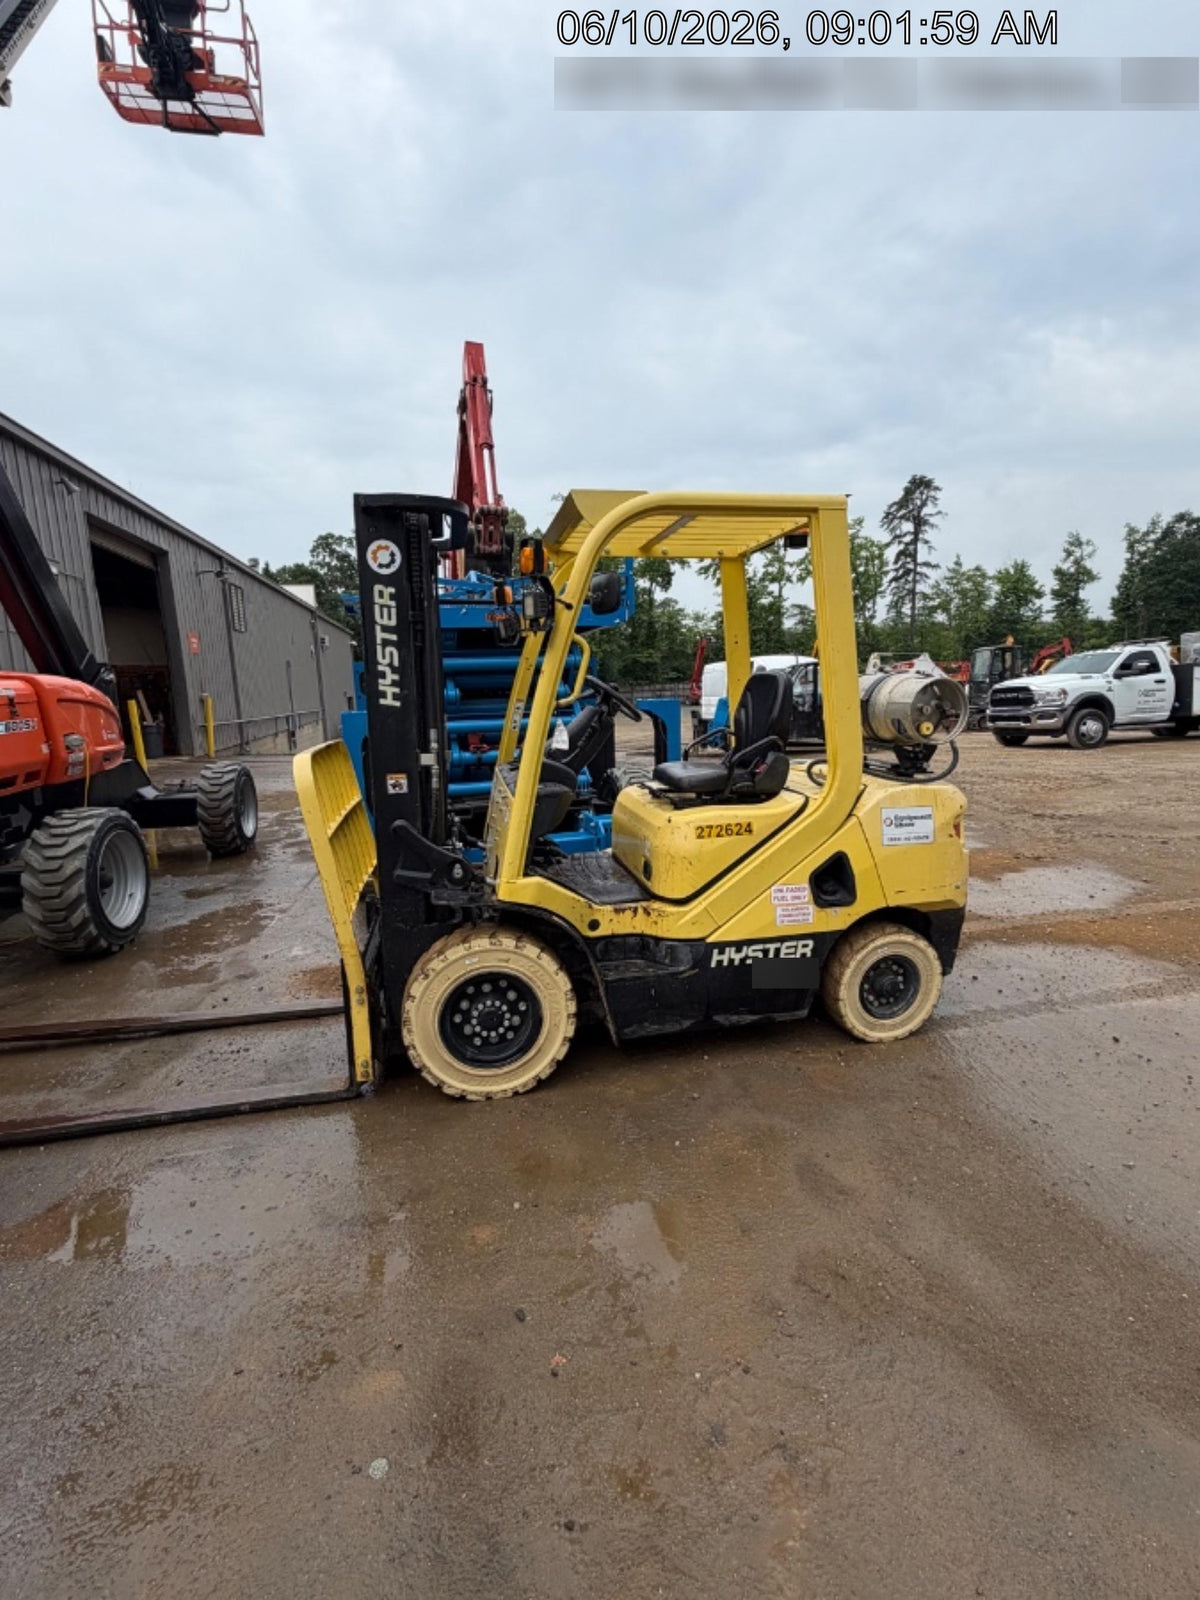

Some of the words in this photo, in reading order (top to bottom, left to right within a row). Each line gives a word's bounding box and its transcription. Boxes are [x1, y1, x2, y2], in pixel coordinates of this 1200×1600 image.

[373, 584, 401, 707] HYSTER
[694, 821, 753, 840] 272624
[710, 939, 814, 968] HYSTER
